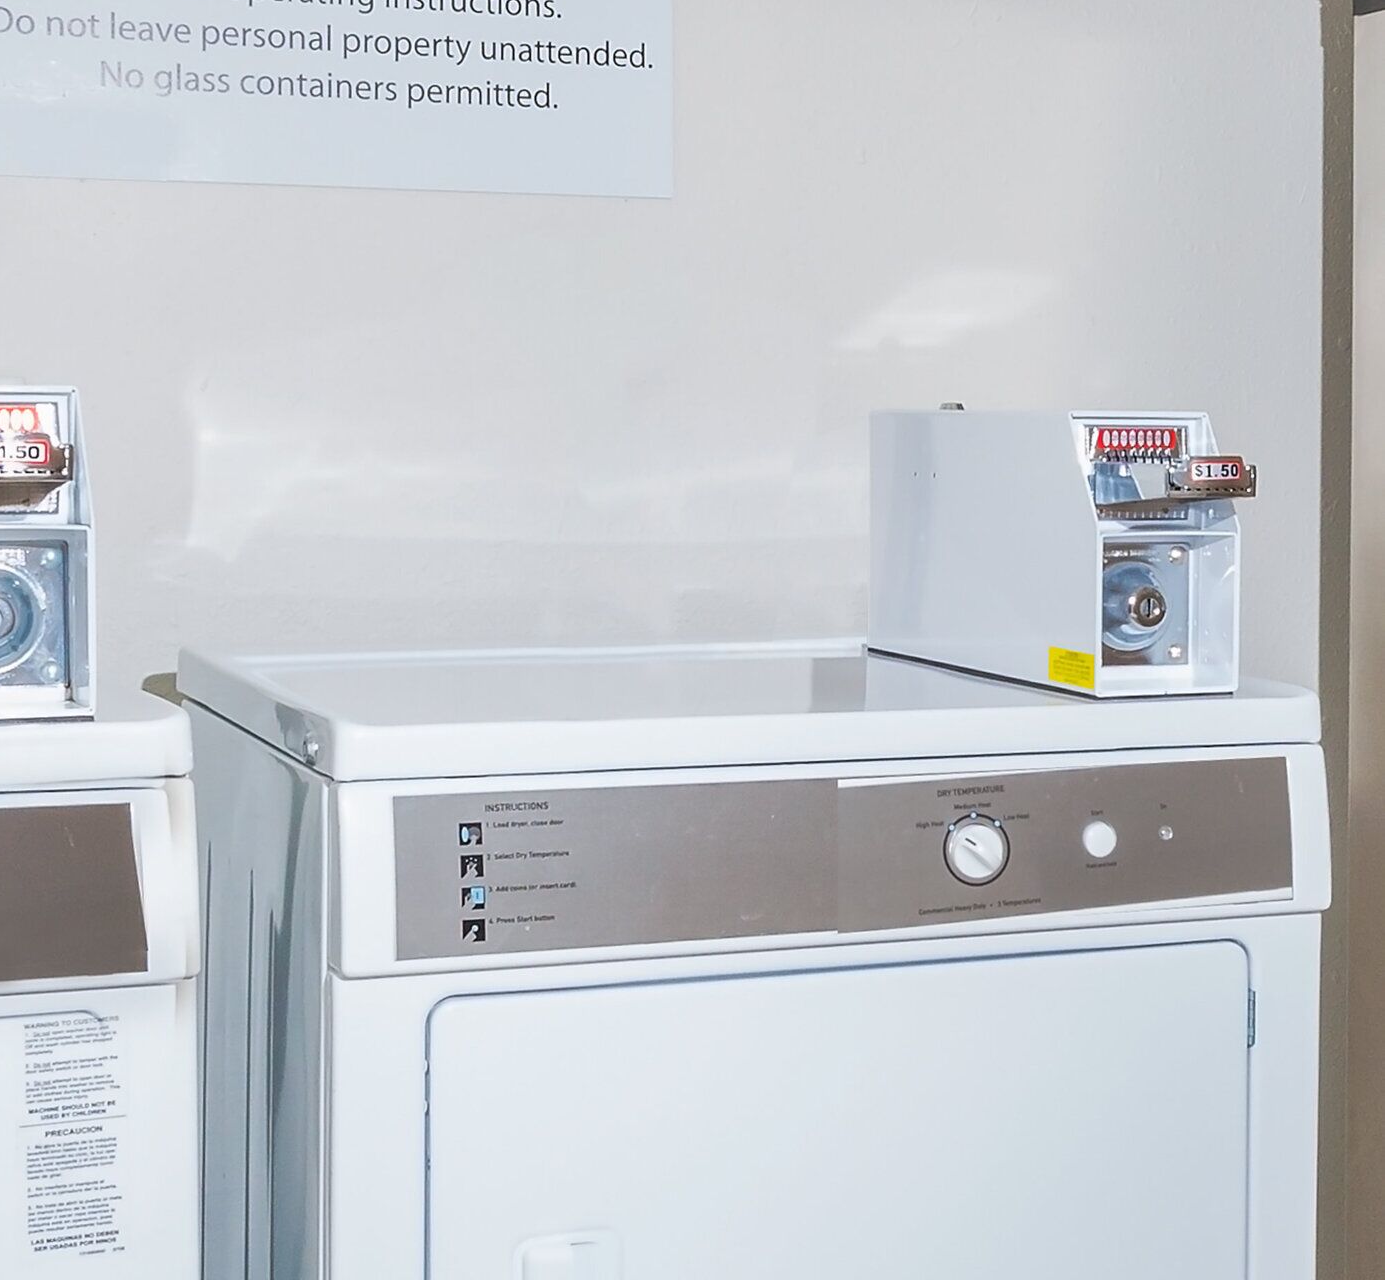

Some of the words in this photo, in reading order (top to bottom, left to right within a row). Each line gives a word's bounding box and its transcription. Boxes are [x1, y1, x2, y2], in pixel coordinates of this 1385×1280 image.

[46, 15, 100, 38] not
[111, 12, 191, 43] leave
[202, 24, 331, 52] personal
[343, 33, 471, 66] property
[481, 40, 653, 69] unattended.
[101, 61, 144, 88] No
[154, 63, 230, 97] glass
[240, 72, 397, 101] containers
[408, 81, 558, 109] permitted.
[1195, 463, 1239, 478] $1.50
[937, 789, 951, 797] DRY
[953, 785, 1005, 796] TEMPERATURE
[485, 801, 549, 812] INSTRUCTIONS
[45, 1126, 103, 1138] PRECAUCION
